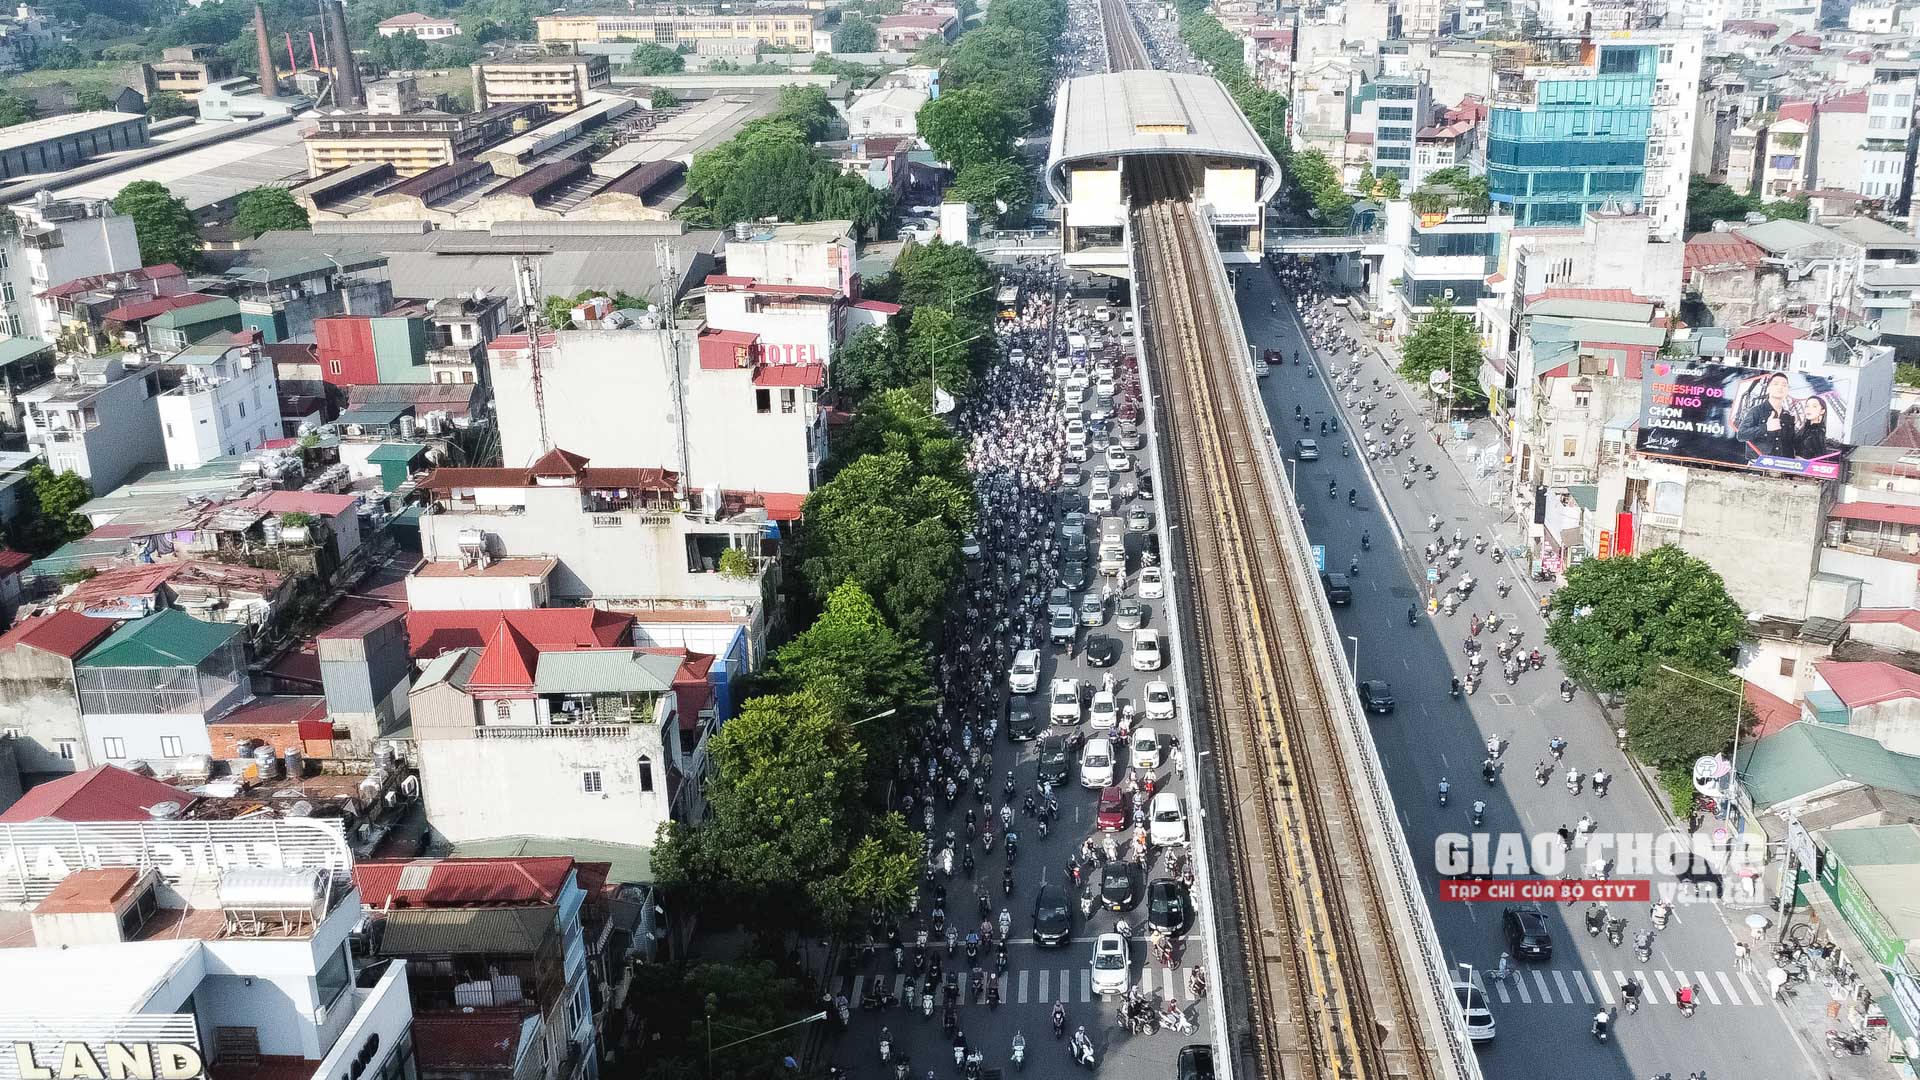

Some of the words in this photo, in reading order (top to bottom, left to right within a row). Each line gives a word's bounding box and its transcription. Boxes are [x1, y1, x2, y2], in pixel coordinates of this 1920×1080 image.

[757, 343, 819, 364] HOTEL
[1651, 382, 1705, 395] FREESHIP
[1648, 406, 1682, 419] CHỌN
[1647, 418, 1693, 431] LAZADA
[1695, 421, 1725, 435] THÔI
[14, 1041, 203, 1080] LAND
